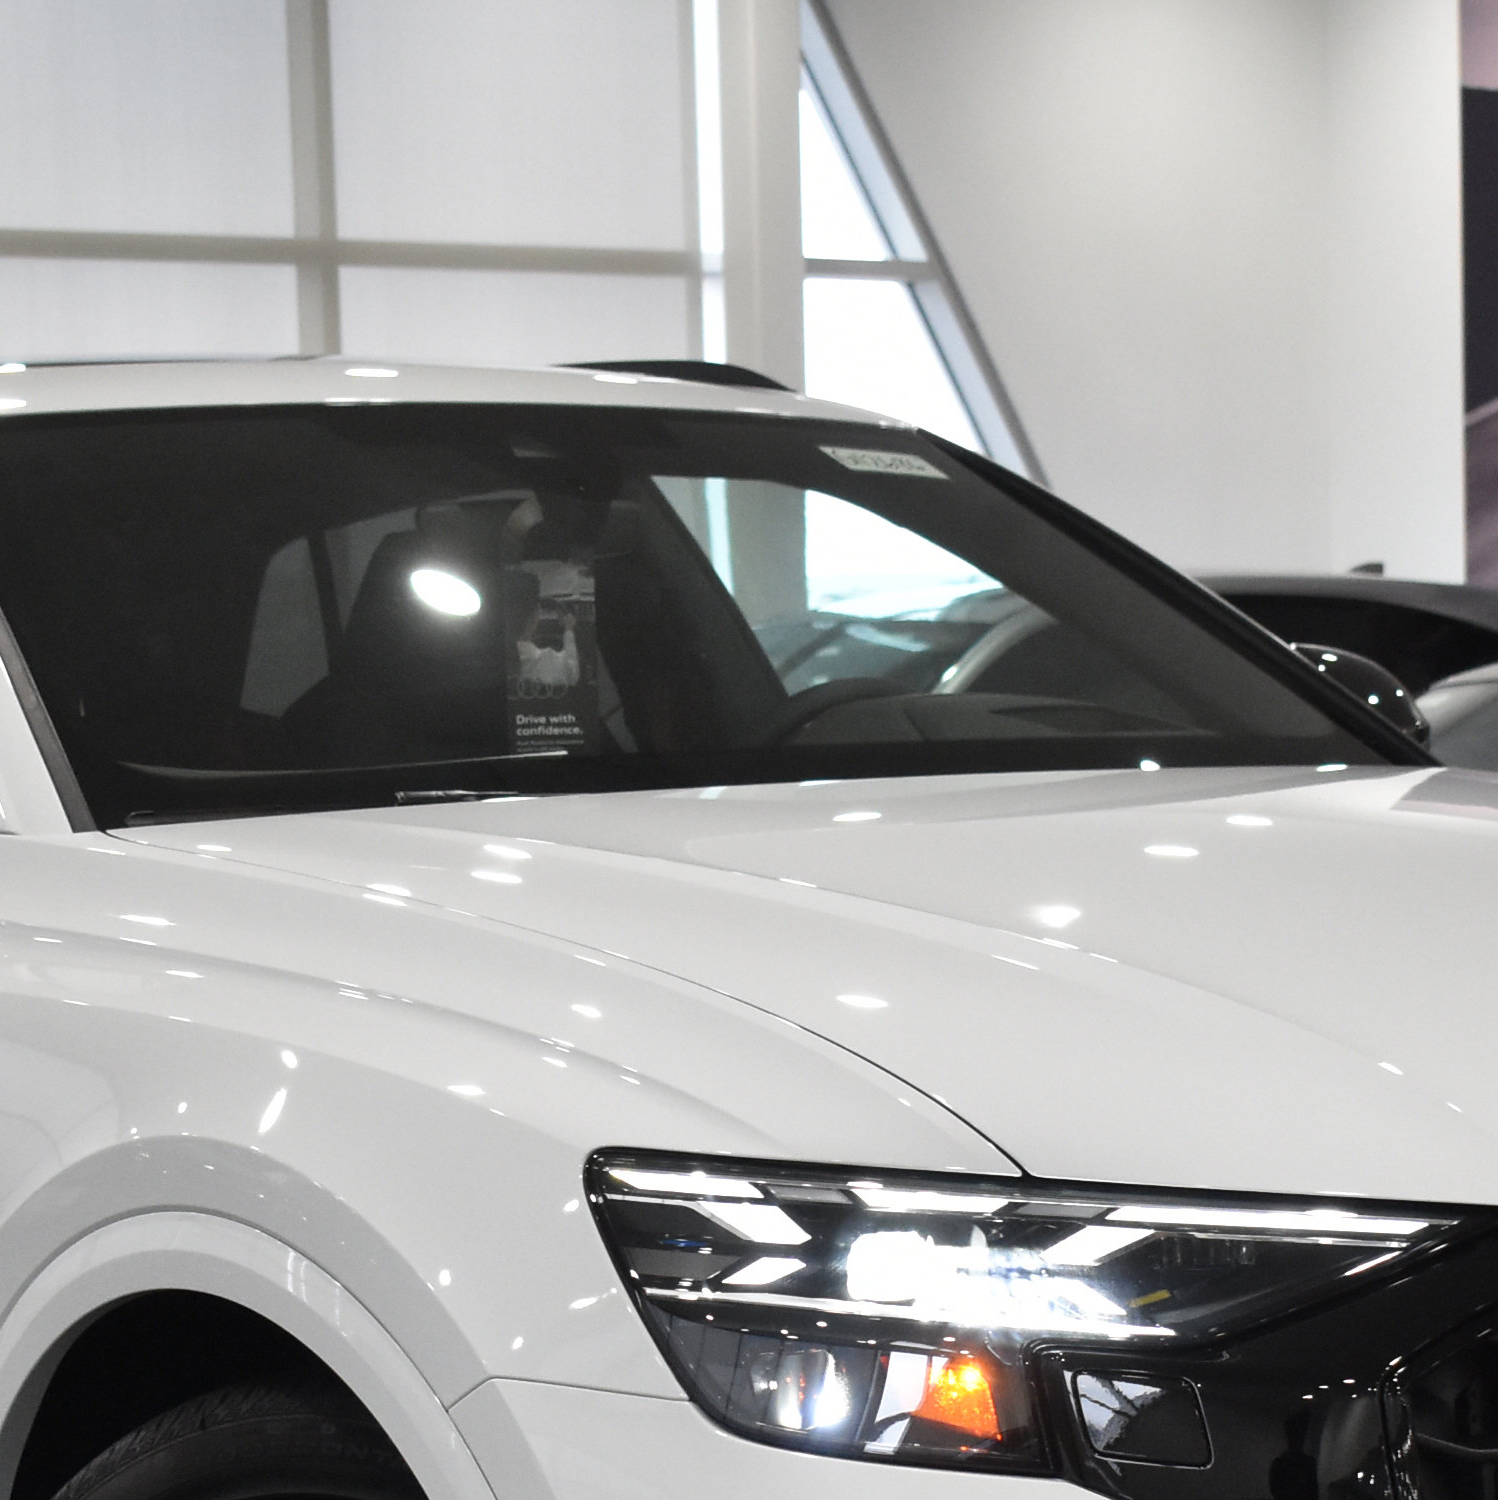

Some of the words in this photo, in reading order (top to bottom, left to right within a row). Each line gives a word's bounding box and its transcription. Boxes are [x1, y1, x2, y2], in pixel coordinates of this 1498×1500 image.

[516, 714, 547, 725] Drive
[549, 713, 576, 724] with
[516, 726, 583, 736] confidence.
